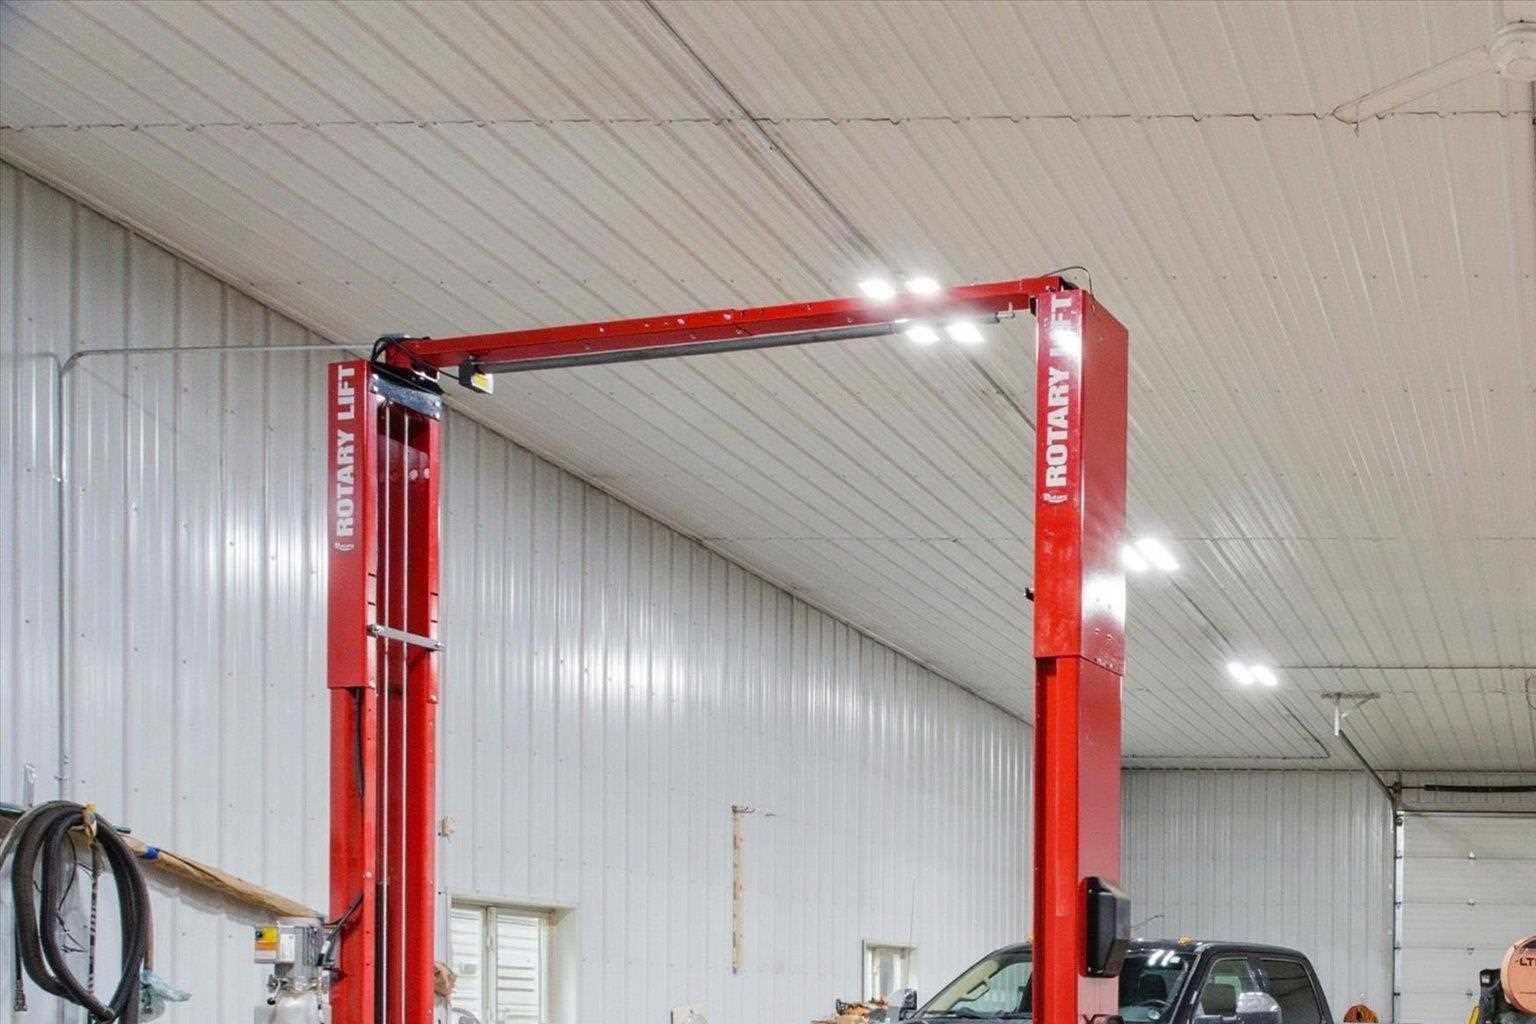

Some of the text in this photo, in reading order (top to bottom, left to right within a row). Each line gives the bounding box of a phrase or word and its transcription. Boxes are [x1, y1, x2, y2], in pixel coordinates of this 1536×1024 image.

[1049, 293, 1073, 358] LFT
[337, 365, 355, 421] LIFT
[1045, 366, 1071, 488] ROTARY
[336, 428, 355, 537] ROTARY
